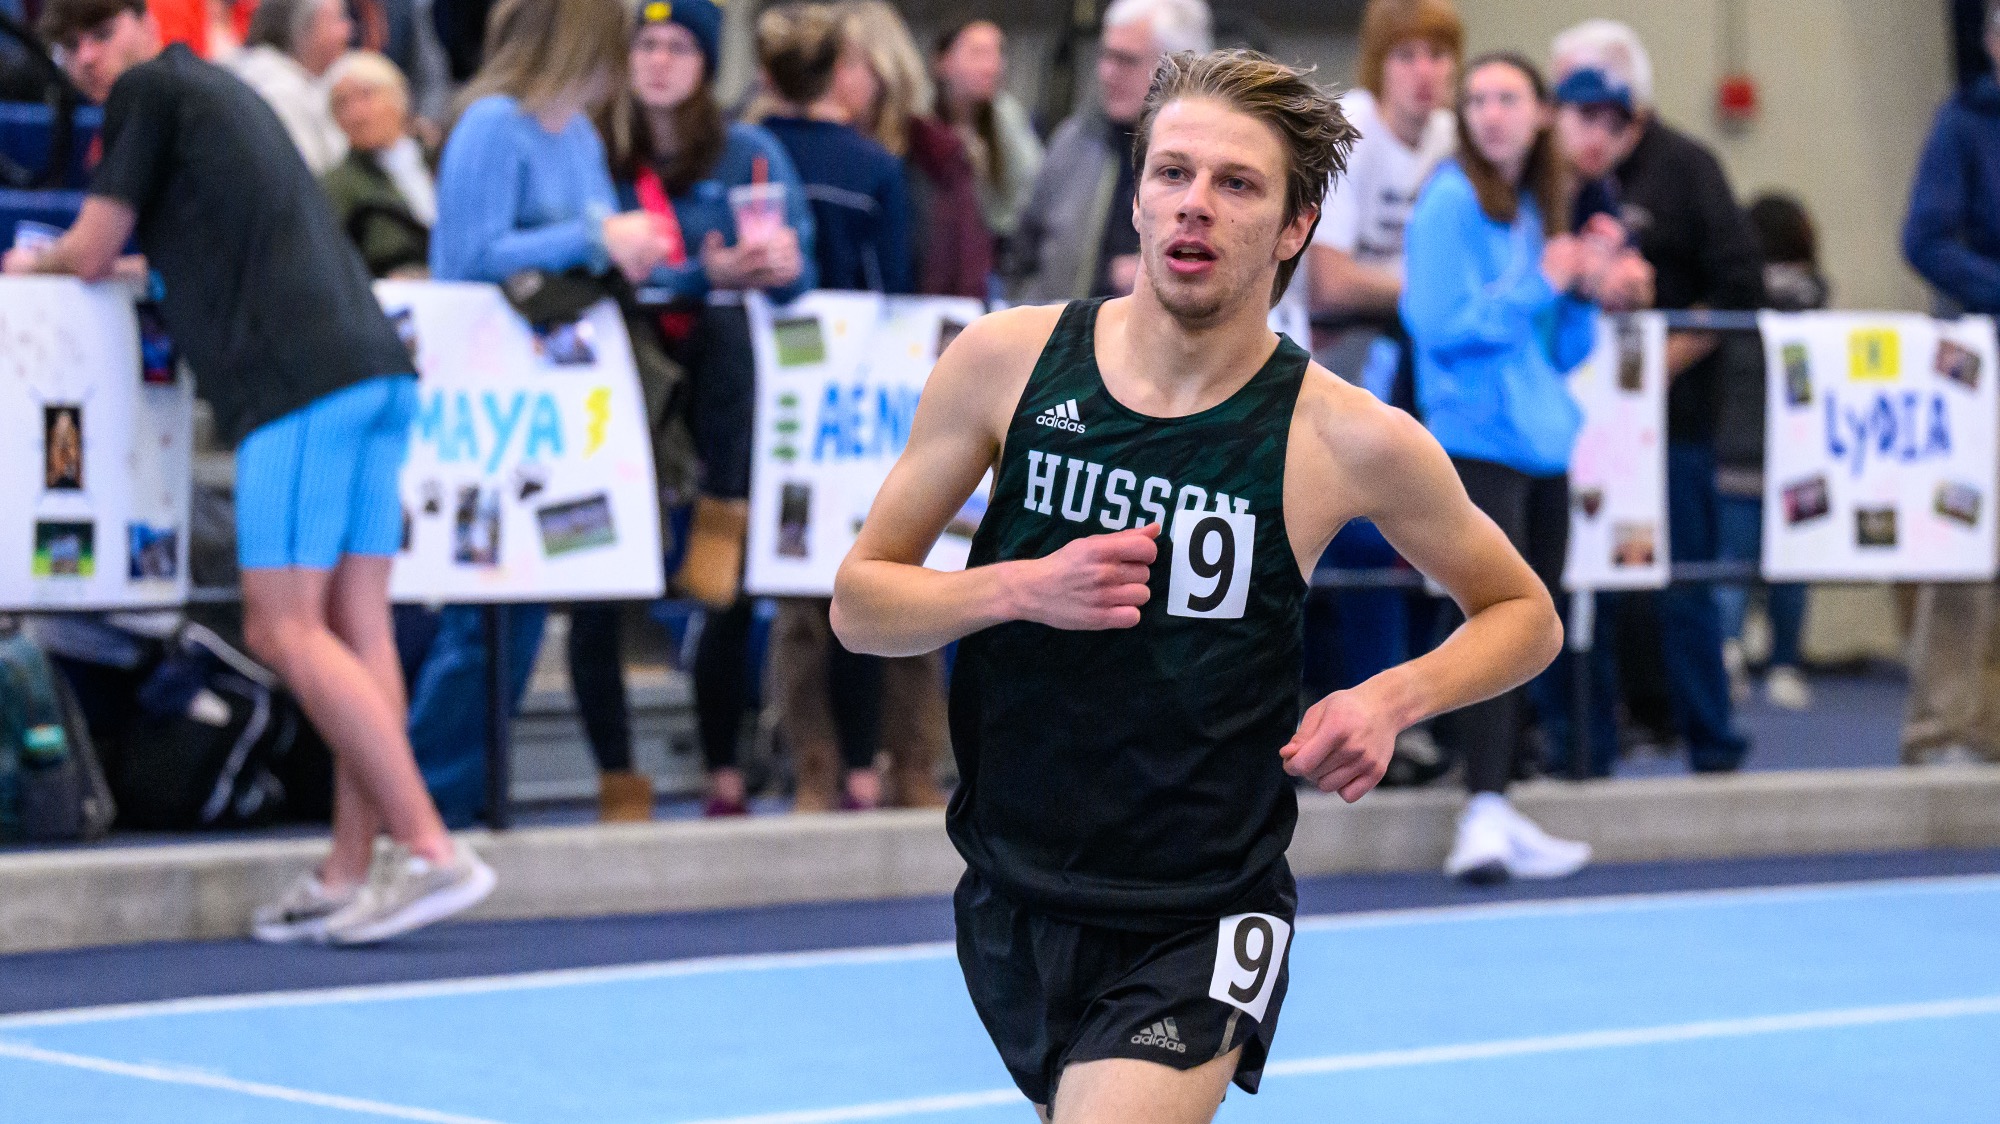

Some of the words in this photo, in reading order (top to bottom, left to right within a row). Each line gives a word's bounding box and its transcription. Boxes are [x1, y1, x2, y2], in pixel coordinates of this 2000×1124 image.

[414, 387, 566, 474] MAYA
[1035, 413, 1086, 434] adidas
[1186, 516, 1236, 613] 9
[1227, 915, 1274, 1004] 9
[1130, 1033, 1187, 1054] adidas
